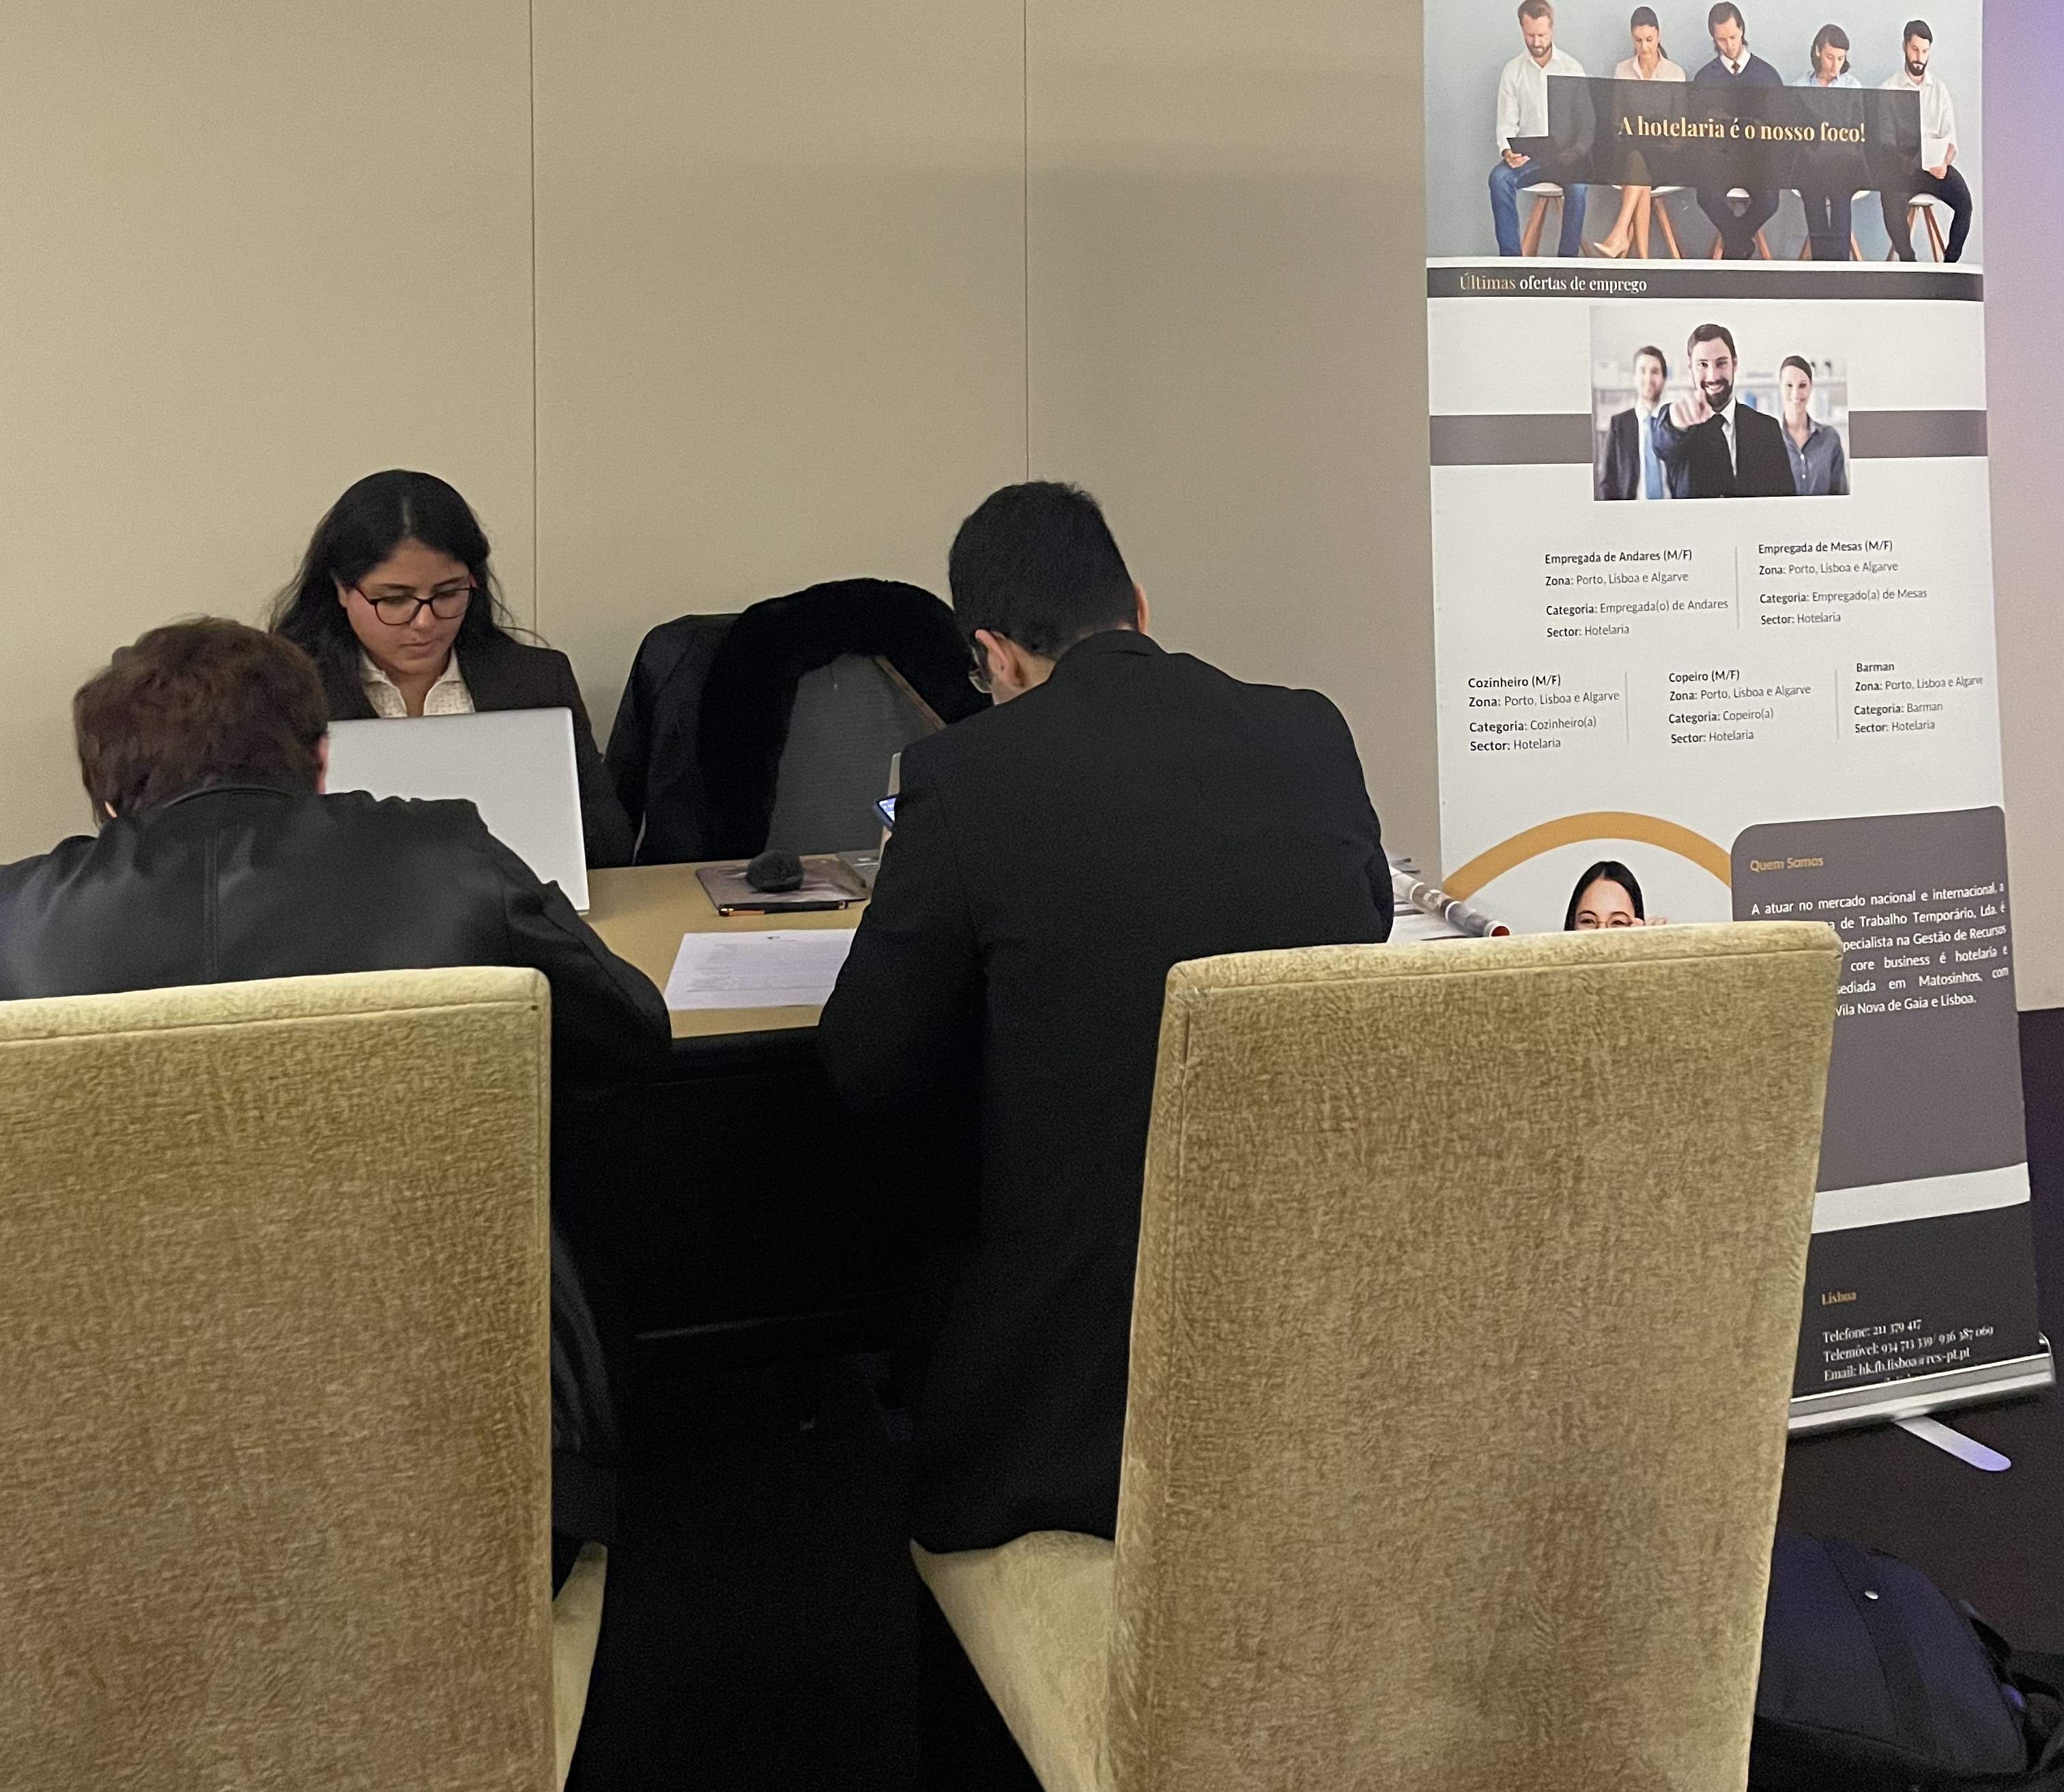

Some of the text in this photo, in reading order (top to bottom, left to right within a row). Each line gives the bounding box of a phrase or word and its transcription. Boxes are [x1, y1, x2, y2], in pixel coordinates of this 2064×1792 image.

[1618, 115, 1866, 143] A hotelaria é o nosso foco!
[1460, 272, 1647, 294] Últimas ofertas de emprego
[1759, 540, 1893, 555] Empregada de Mesas (M/F)
[1545, 549, 1693, 565] Empregada de Andares (M/F)
[1759, 562, 1899, 575] Zona: Porto, Lisboa e Algarve
[1545, 572, 1689, 586] Zona: Porto, Lisboa e Algarve
[1760, 589, 1927, 605] Categoria: Empregado(a) de Mesas
[1546, 599, 1729, 617] Categoria: Empregada(o) de Andares
[1761, 612, 1841, 625] Sector: Hotelaria
[1547, 624, 1630, 638] Sector: Hotelaria
[1857, 662, 1895, 673] Barman
[1468, 674, 1562, 689] Cozinheiro (M/F)
[1669, 669, 1740, 684] Copeiro (M/F)
[1855, 676, 1984, 691] Zona: Porto, Lisboa e Algarve
[1468, 691, 1620, 708] Zona: Porto, Lisboa e Algarve
[1669, 691, 1698, 701] Zona:
[1701, 689, 1732, 700] Porto,
[1734, 687, 1764, 698] Lisboa
[1775, 685, 1811, 697] Algarve
[1668, 708, 1774, 725] Categoria: Copeiro(a)
[1854, 703, 1943, 717] Categoria: Barman
[1470, 716, 1597, 734] Categoria: Cozinheiro(a)
[1854, 721, 1936, 734] Sector: Hotelaria
[1470, 737, 1562, 751] Sector: Hotelaria
[1671, 729, 1755, 744] Sector: Hotelaria
[1750, 856, 1824, 873] Quem Somos
[1751, 882, 2005, 915] A atuar no mercado nacional e internacional, a
[1840, 917, 1854, 929] de
[1859, 912, 1908, 927] Trabalho
[1912, 906, 1977, 923] Temporário,
[1980, 904, 1998, 917] Lda.
[2000, 900, 2005, 913] é
[1843, 925, 2007, 953] pecialista na Gestão de Recursos
[1850, 946, 2008, 971] core business é hotelaria e
[1889, 979, 1906, 989] em
[1919, 971, 1983, 987] Matosinhos,
[1992, 966, 2009, 979] com
[1836, 994, 1977, 1016] Vila Nova de Gaia e Lisboa.
[1822, 1290, 1857, 1305] Lisboa
[1822, 1327, 1871, 1343] Telefone:
[1824, 1342, 1879, 1363] Telemóvel:
[1824, 1365, 1857, 1382] Email:
